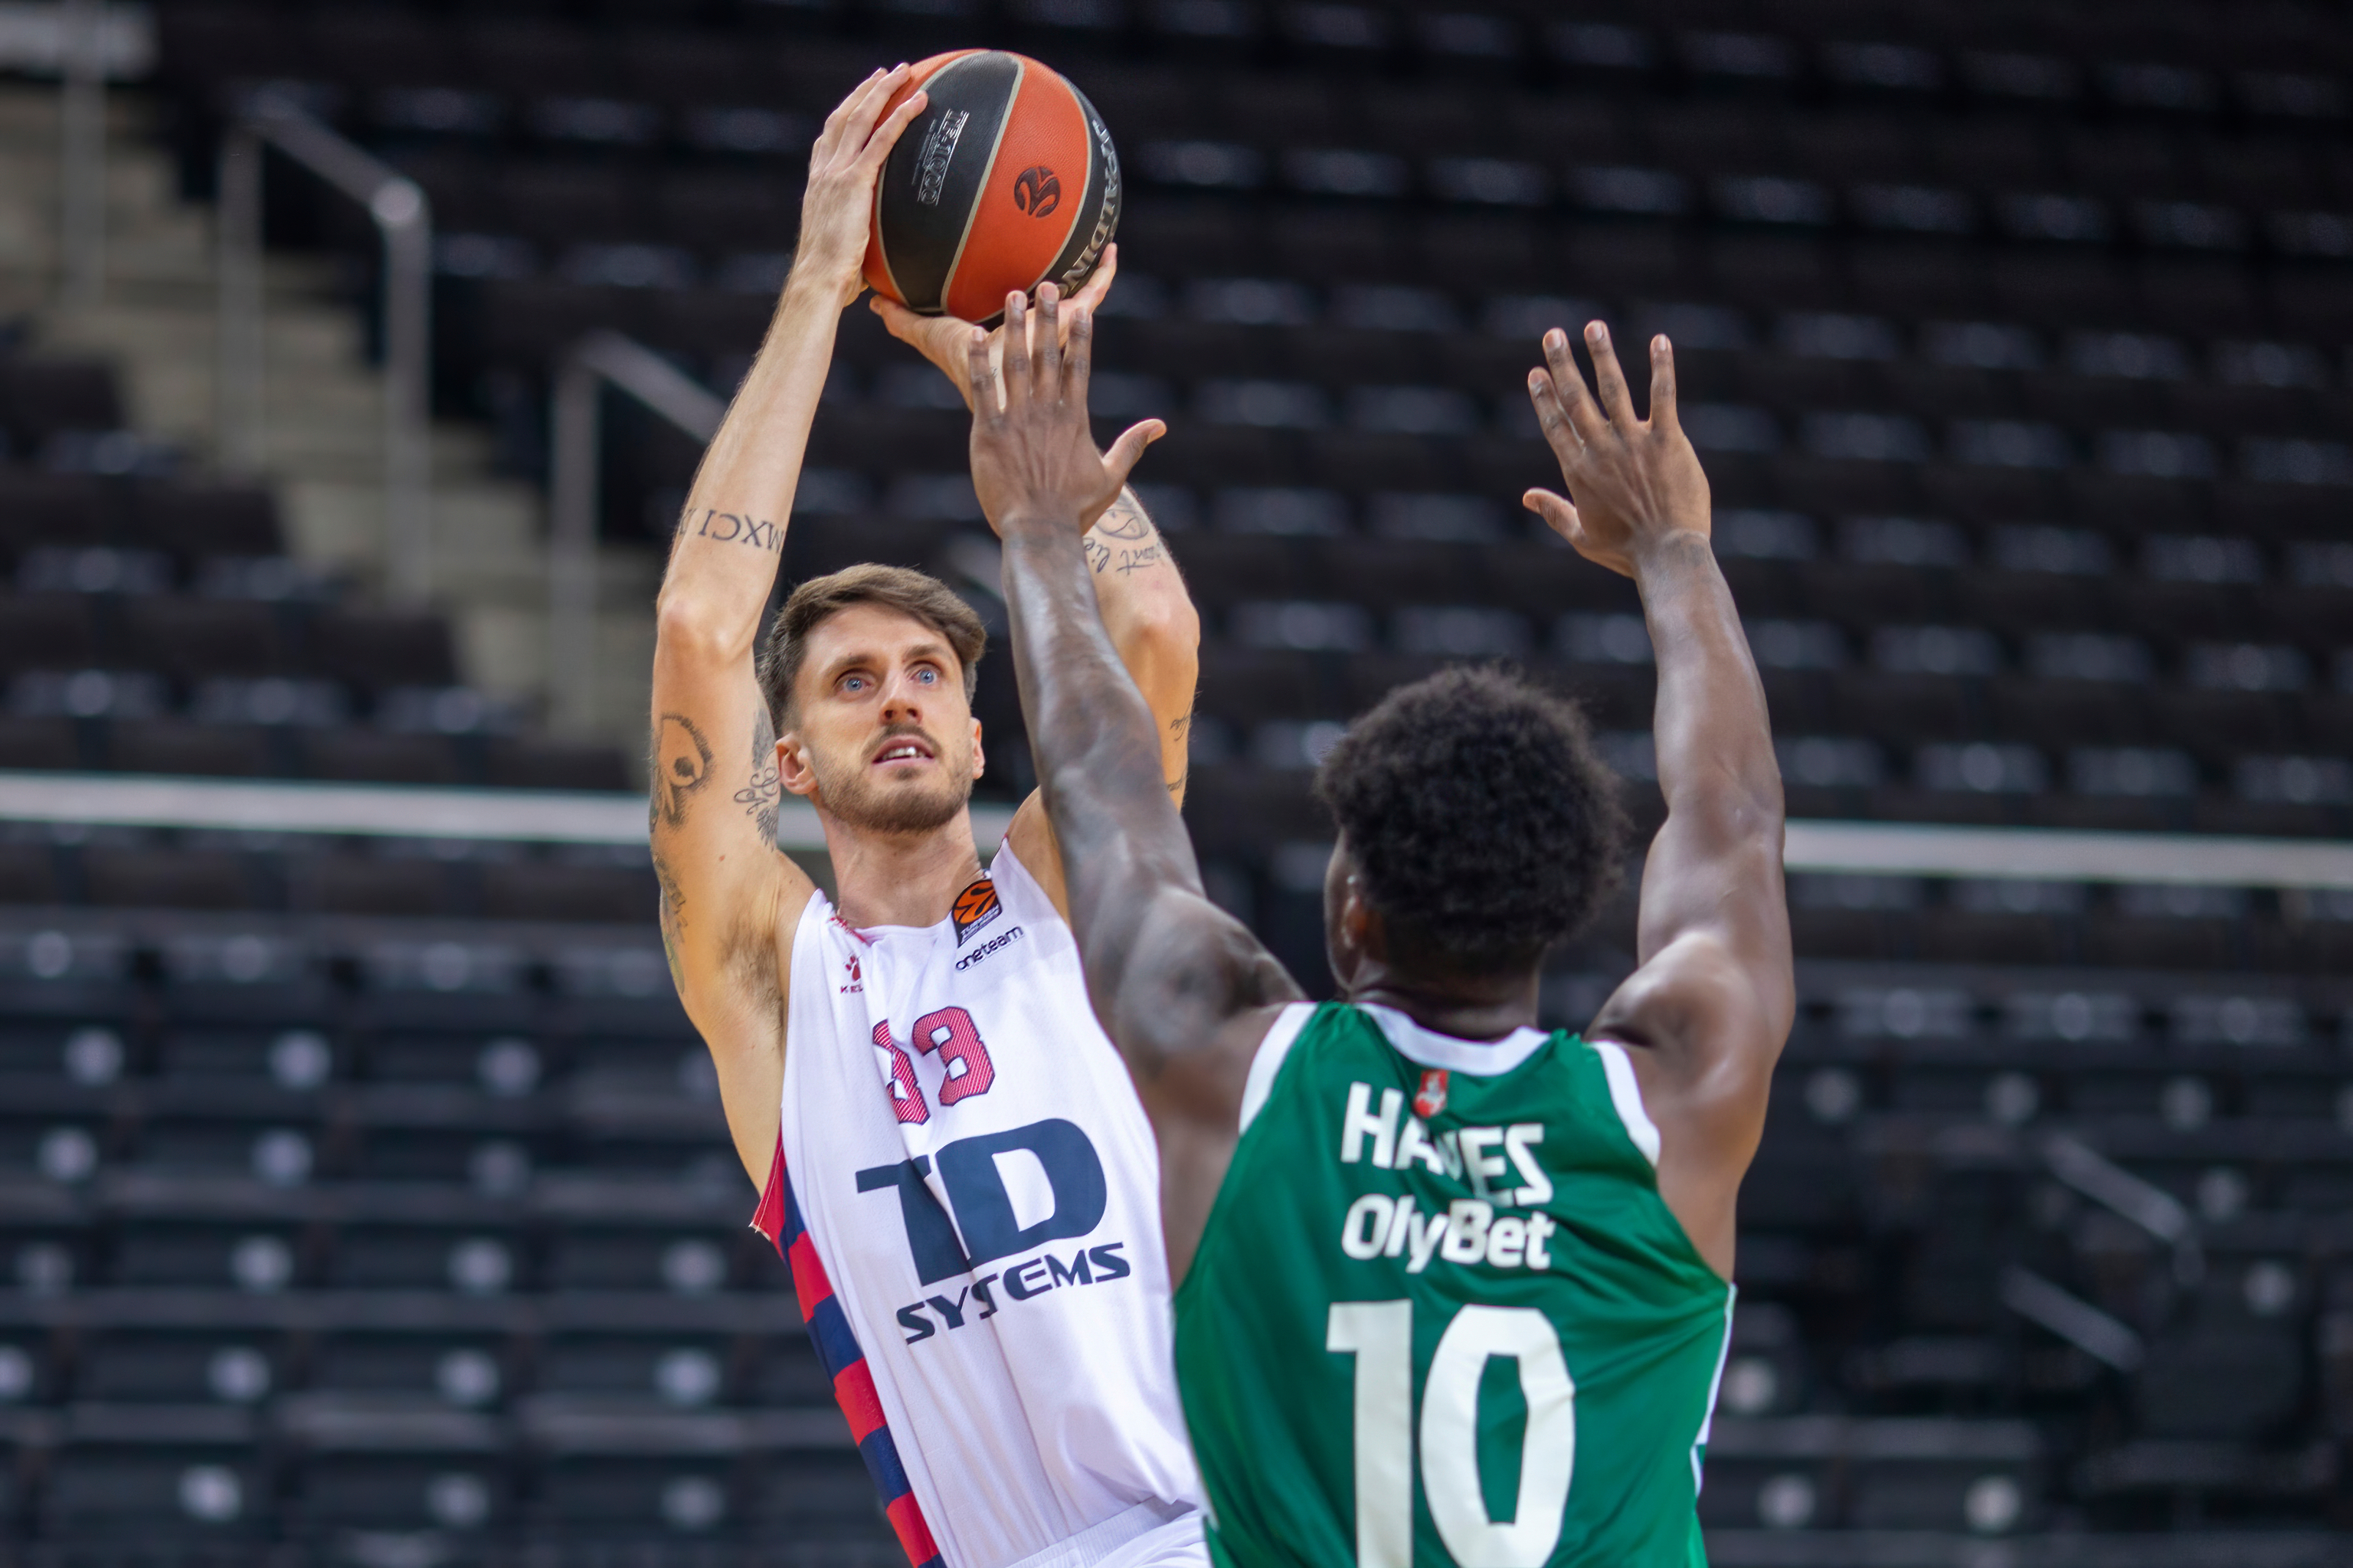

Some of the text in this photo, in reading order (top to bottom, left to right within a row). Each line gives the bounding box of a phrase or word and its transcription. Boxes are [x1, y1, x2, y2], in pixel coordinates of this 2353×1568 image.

[955, 926, 1023, 971] oneteam
[856, 1118, 1108, 1288] TD
[1342, 1193, 1556, 1274] OlyBet
[1326, 1298, 1576, 1568] 10
